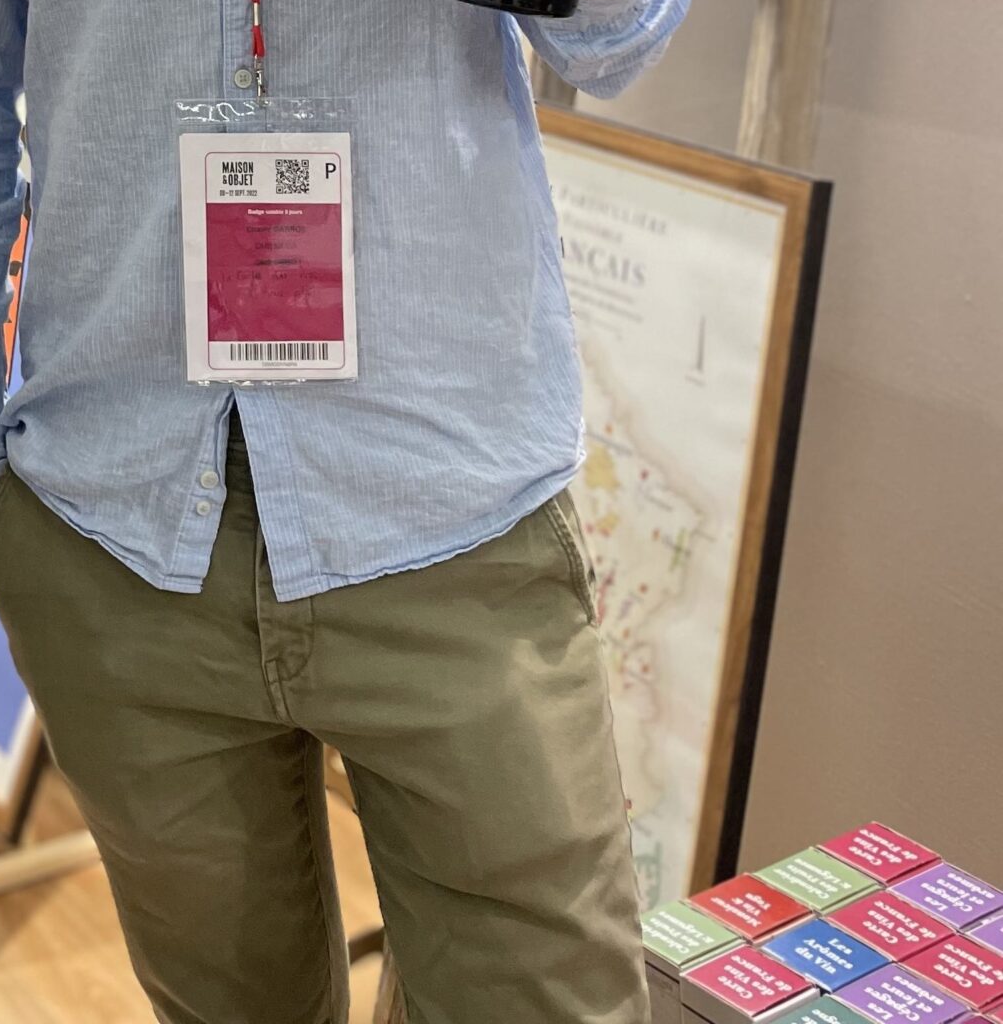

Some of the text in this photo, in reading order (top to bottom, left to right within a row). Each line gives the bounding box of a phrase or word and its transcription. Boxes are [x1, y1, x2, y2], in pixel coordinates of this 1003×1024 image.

[222, 161, 254, 174] MAISON
[325, 162, 337, 179] P
[848, 845, 882, 866] Carte
[853, 836, 902, 864] des Vins
[859, 829, 918, 860] de France
[920, 882, 973, 912] Cépages
[936, 878, 969, 899] leurs
[947, 872, 995, 899] arômes
[924, 896, 948, 911] Les
[862, 921, 898, 944] Carte
[867, 910, 920, 943] des Vins
[874, 900, 937, 939] de France
[795, 946, 837, 975] du Vin
[803, 938, 854, 970] Arômes
[828, 938, 853, 955] Les
[944, 943, 993, 972] France
[723, 964, 776, 997] des Vins
[731, 954, 793, 993] de France
[933, 964, 972, 988] Carte
[938, 953, 994, 985] des Vins
[718, 975, 753, 1000] Carte
[880, 982, 933, 1013] et leurs
[893, 975, 945, 1006] arômes
[863, 986, 921, 1022] Cépages
[867, 1002, 894, 1021] Les
